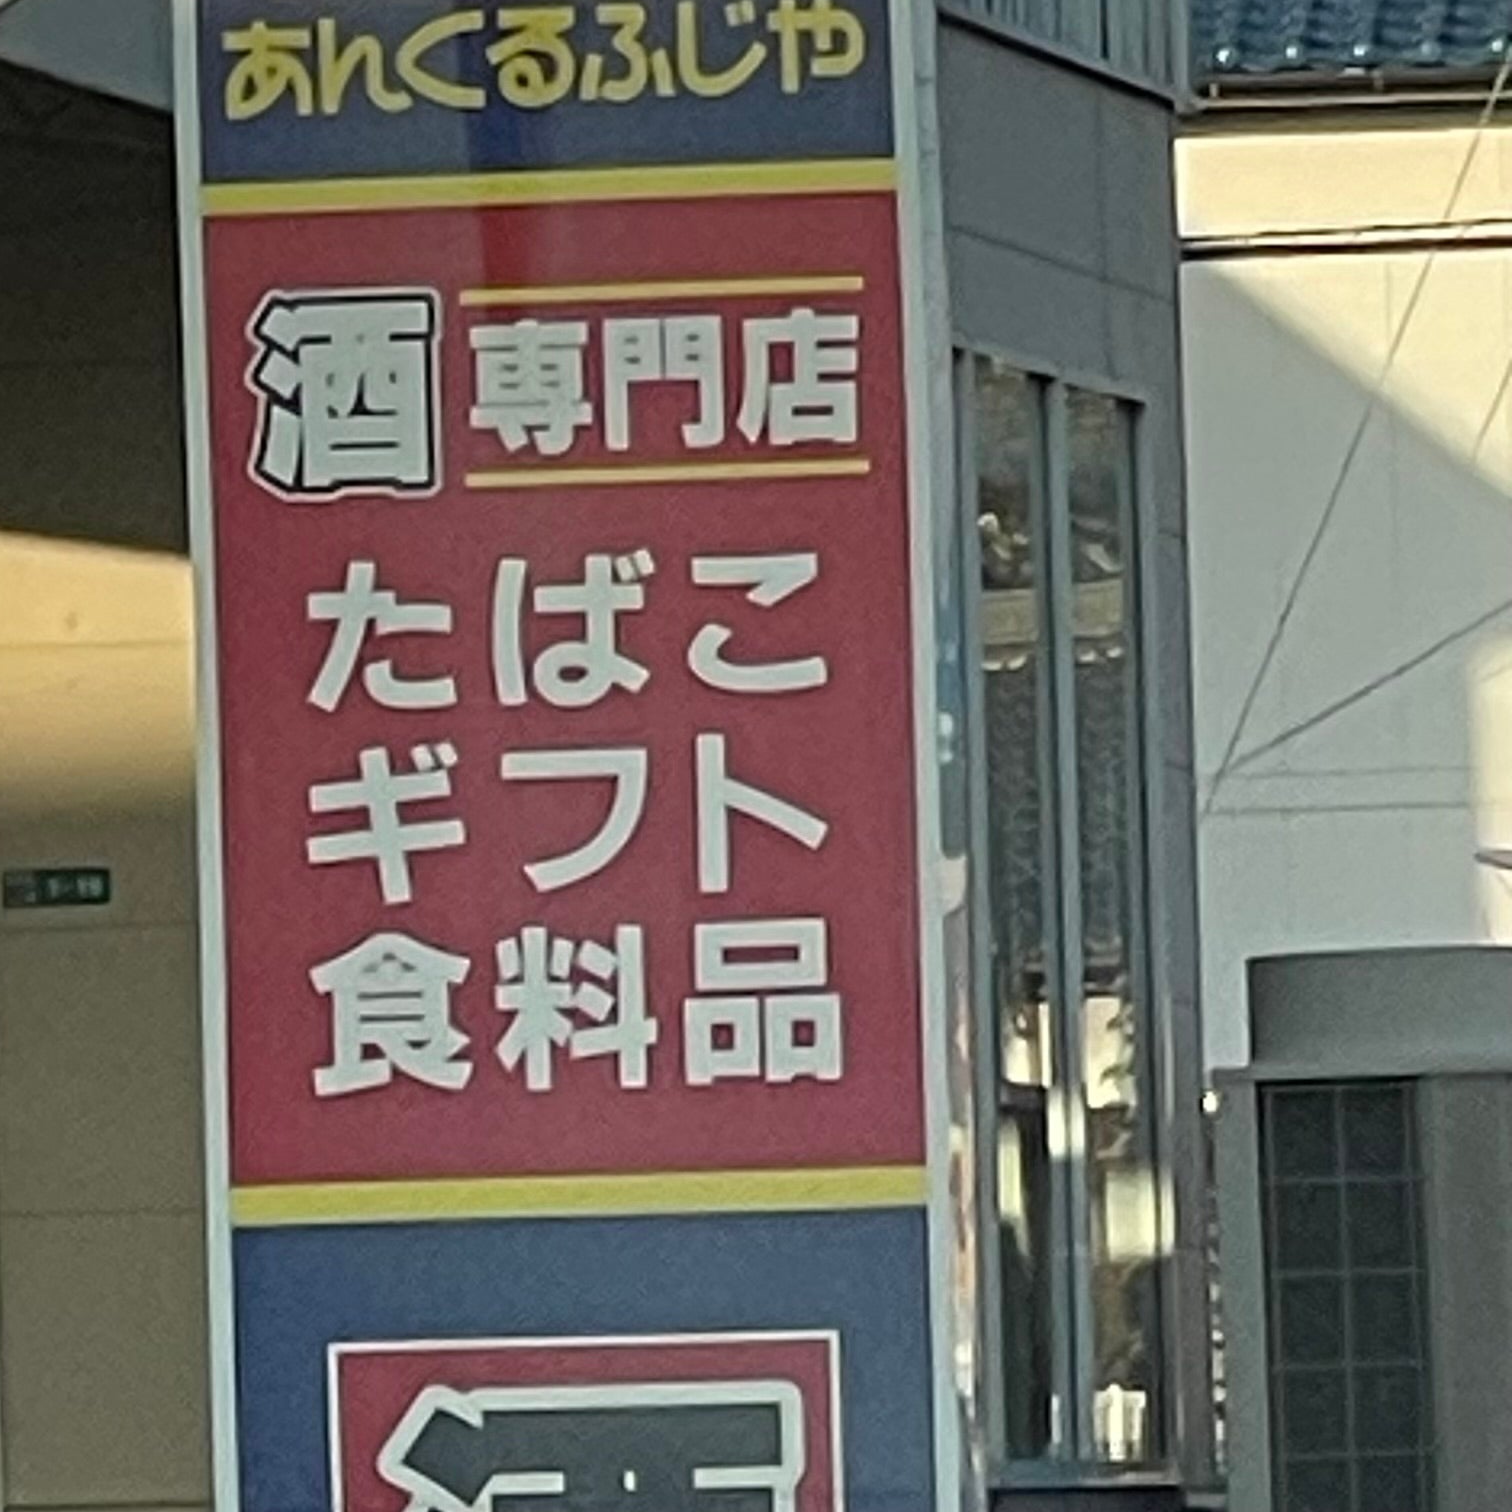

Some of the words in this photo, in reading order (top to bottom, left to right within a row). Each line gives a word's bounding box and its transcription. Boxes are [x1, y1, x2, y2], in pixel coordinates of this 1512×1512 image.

[306, 549, 828, 714] たばこ
[306, 733, 829, 904] ギフト
[308, 917, 843, 1096] 食料品
